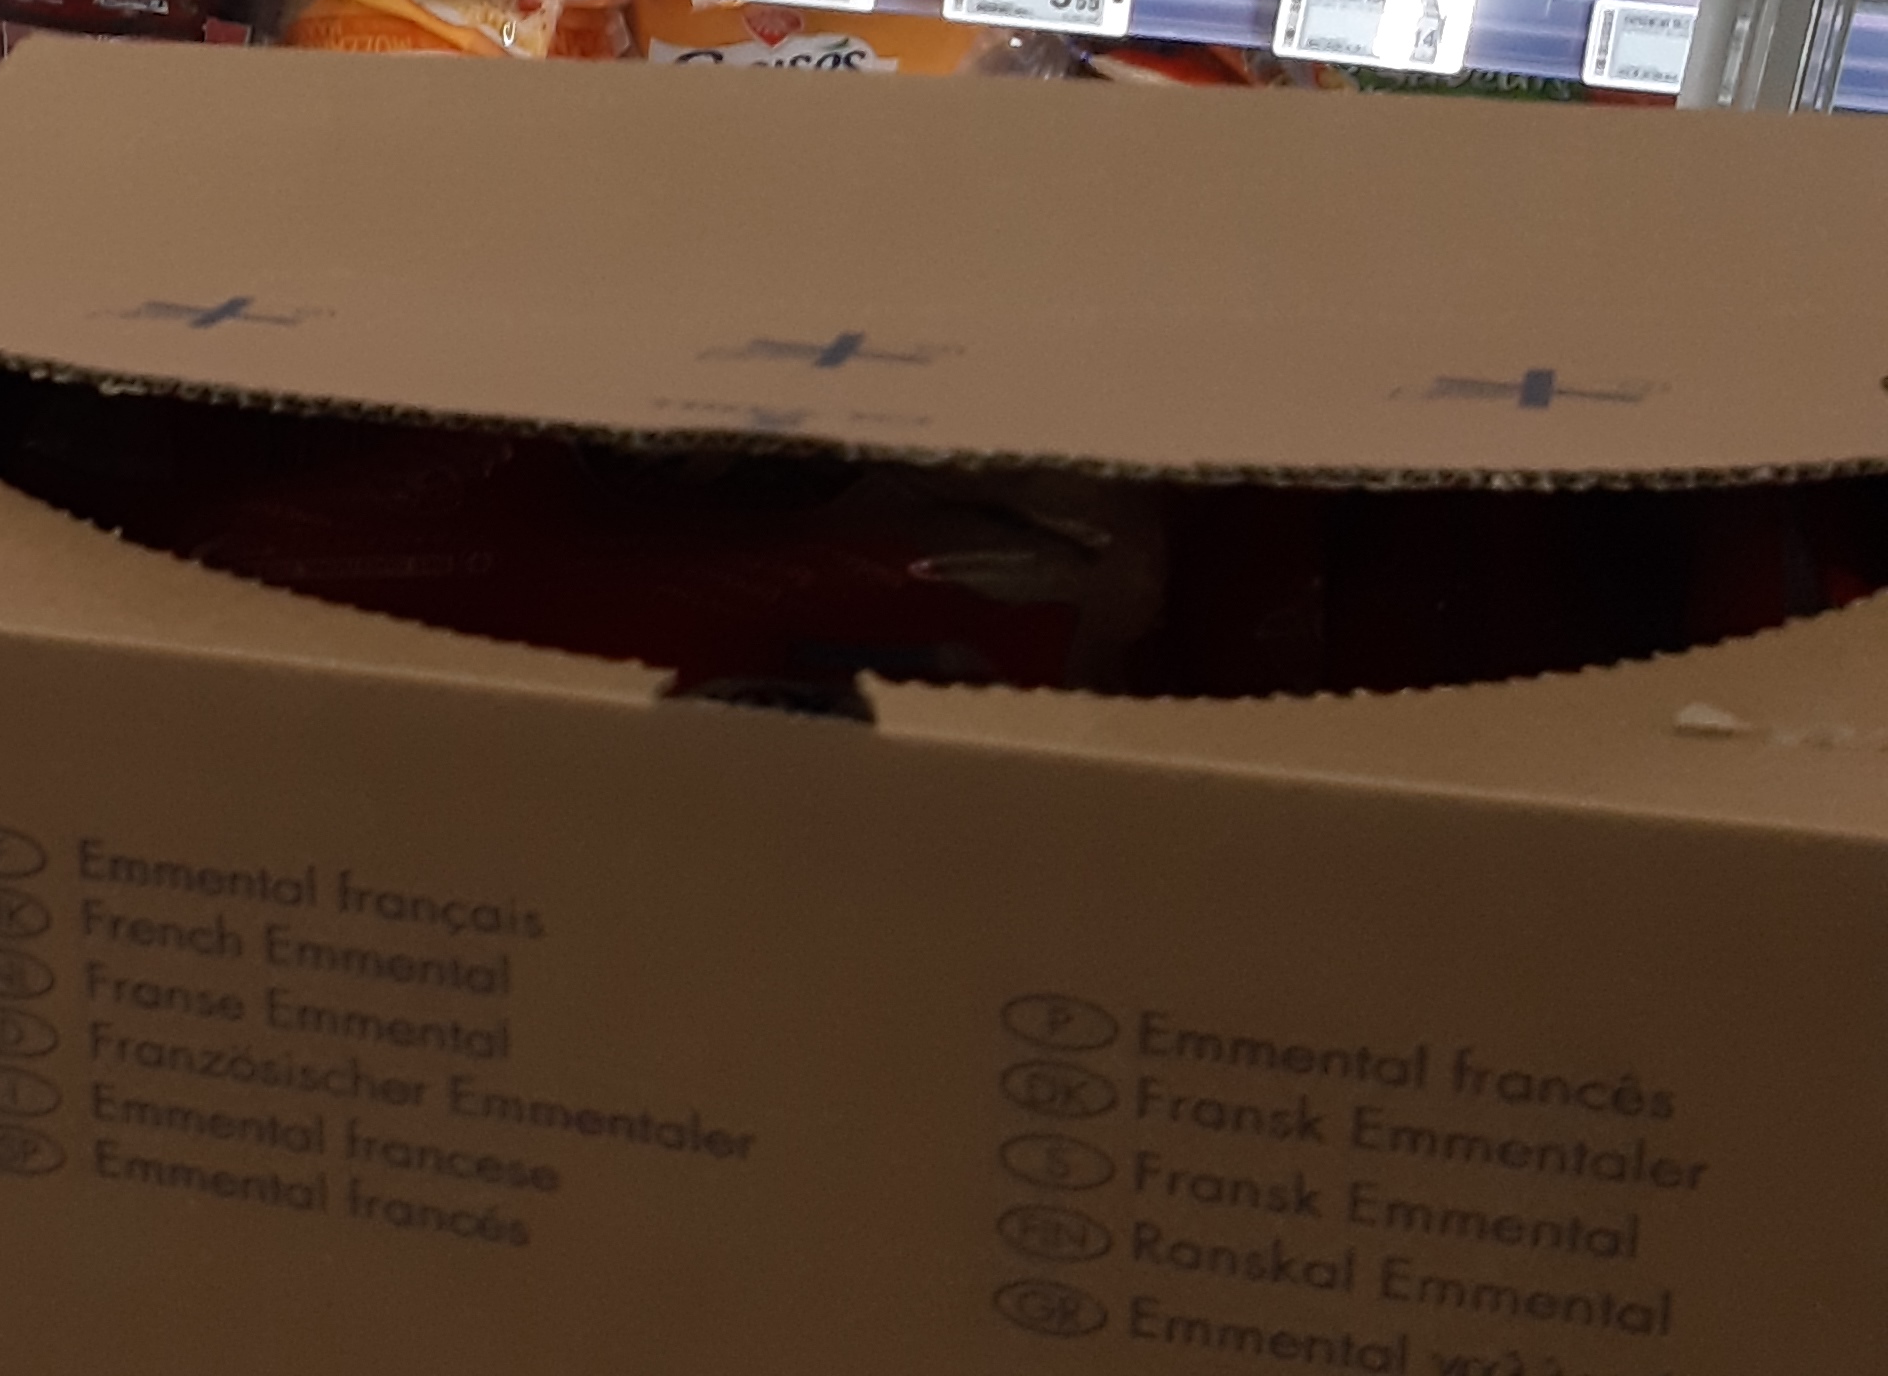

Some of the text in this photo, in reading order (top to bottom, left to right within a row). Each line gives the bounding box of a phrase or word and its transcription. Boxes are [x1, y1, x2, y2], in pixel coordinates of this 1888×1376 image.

[77, 837, 320, 910] Emmental
[334, 872, 547, 943] français
[81, 899, 246, 958] French
[263, 919, 514, 997] Emmental
[85, 959, 513, 1062] Franse Emmental
[1137, 1010, 1428, 1091] Emmental
[88, 1019, 757, 1164] Französischer Emmentaler
[91, 1081, 563, 1196] Emmental francese
[1135, 1079, 1326, 1146] Fransk
[1351, 1107, 1707, 1194] Emmentaler
[94, 1139, 533, 1247] Emmental francés
[1133, 1151, 1324, 1220] Fransk
[1348, 1182, 1643, 1262] Emmental
[1130, 1296, 1412, 1376] Emmental
[1378, 1255, 1676, 1338] Emmental
